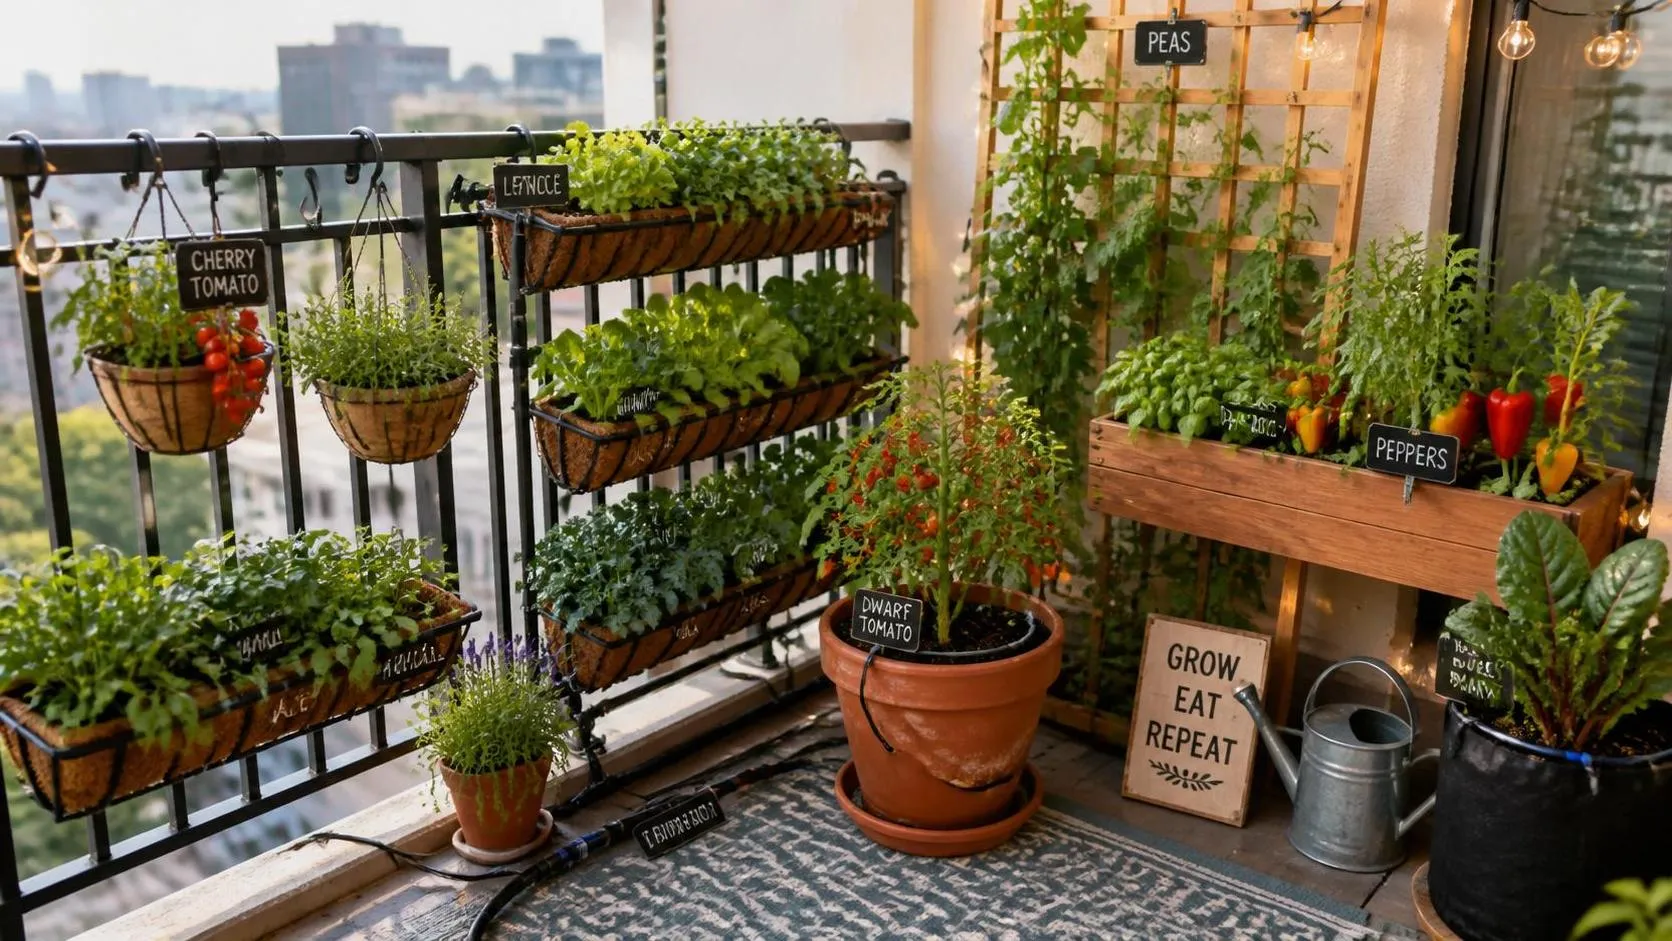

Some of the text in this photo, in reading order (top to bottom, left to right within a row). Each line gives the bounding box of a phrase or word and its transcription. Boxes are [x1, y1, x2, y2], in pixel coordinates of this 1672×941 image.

[1148, 30, 1191, 54] PEAS
[191, 248, 256, 272] CHERRY
[189, 274, 259, 299] TOMATO
[1376, 437, 1448, 470] PEPPERS
[862, 596, 912, 620] DWARF
[859, 615, 912, 642] TOMATO
[1167, 643, 1241, 681] GROW
[1174, 685, 1222, 719] EAT
[1145, 720, 1238, 765] REPEAT
